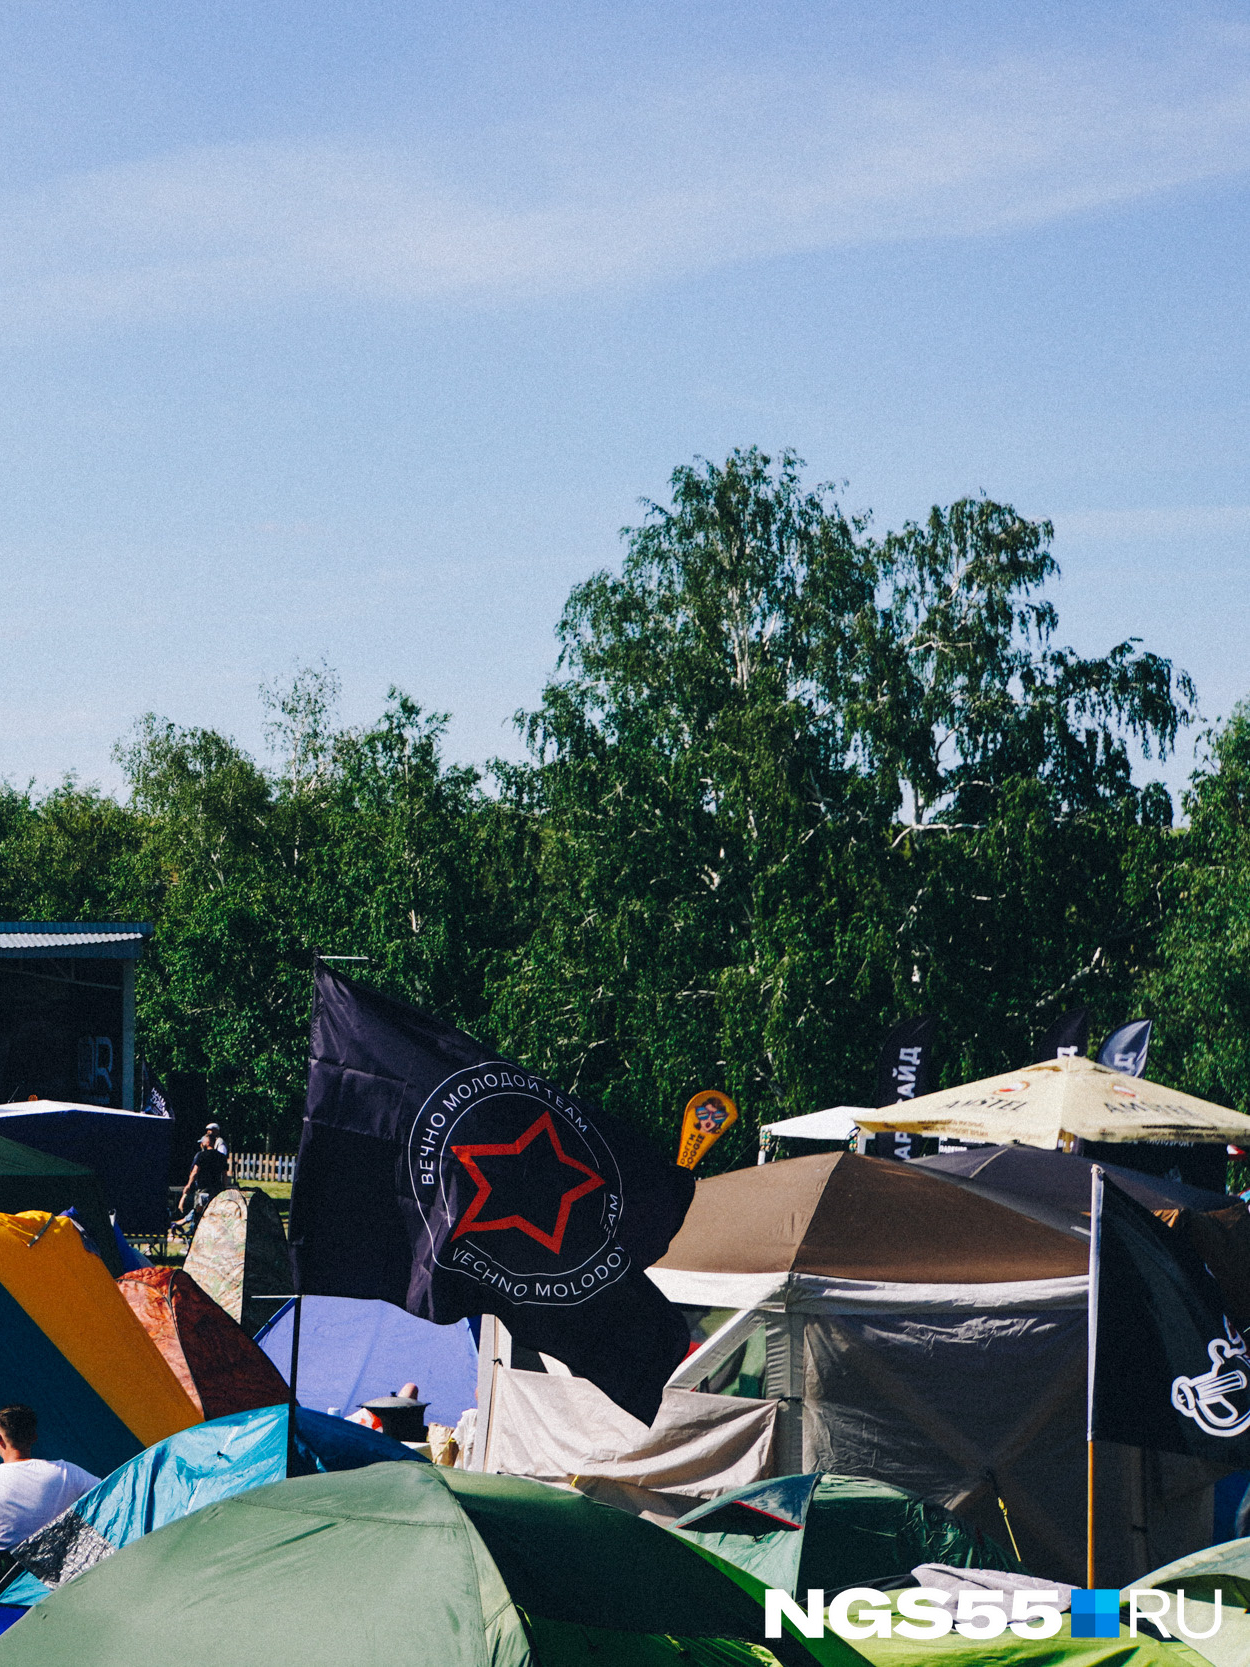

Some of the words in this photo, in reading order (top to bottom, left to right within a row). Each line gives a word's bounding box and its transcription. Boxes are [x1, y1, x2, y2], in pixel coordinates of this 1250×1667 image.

[419, 1112, 446, 1185] ВЕЧНО
[442, 1072, 539, 1112] МОЛОДОЙ
[544, 1087, 588, 1133] TEAM
[452, 1247, 528, 1297] VECHNO
[535, 1245, 625, 1297] MOLODOY
